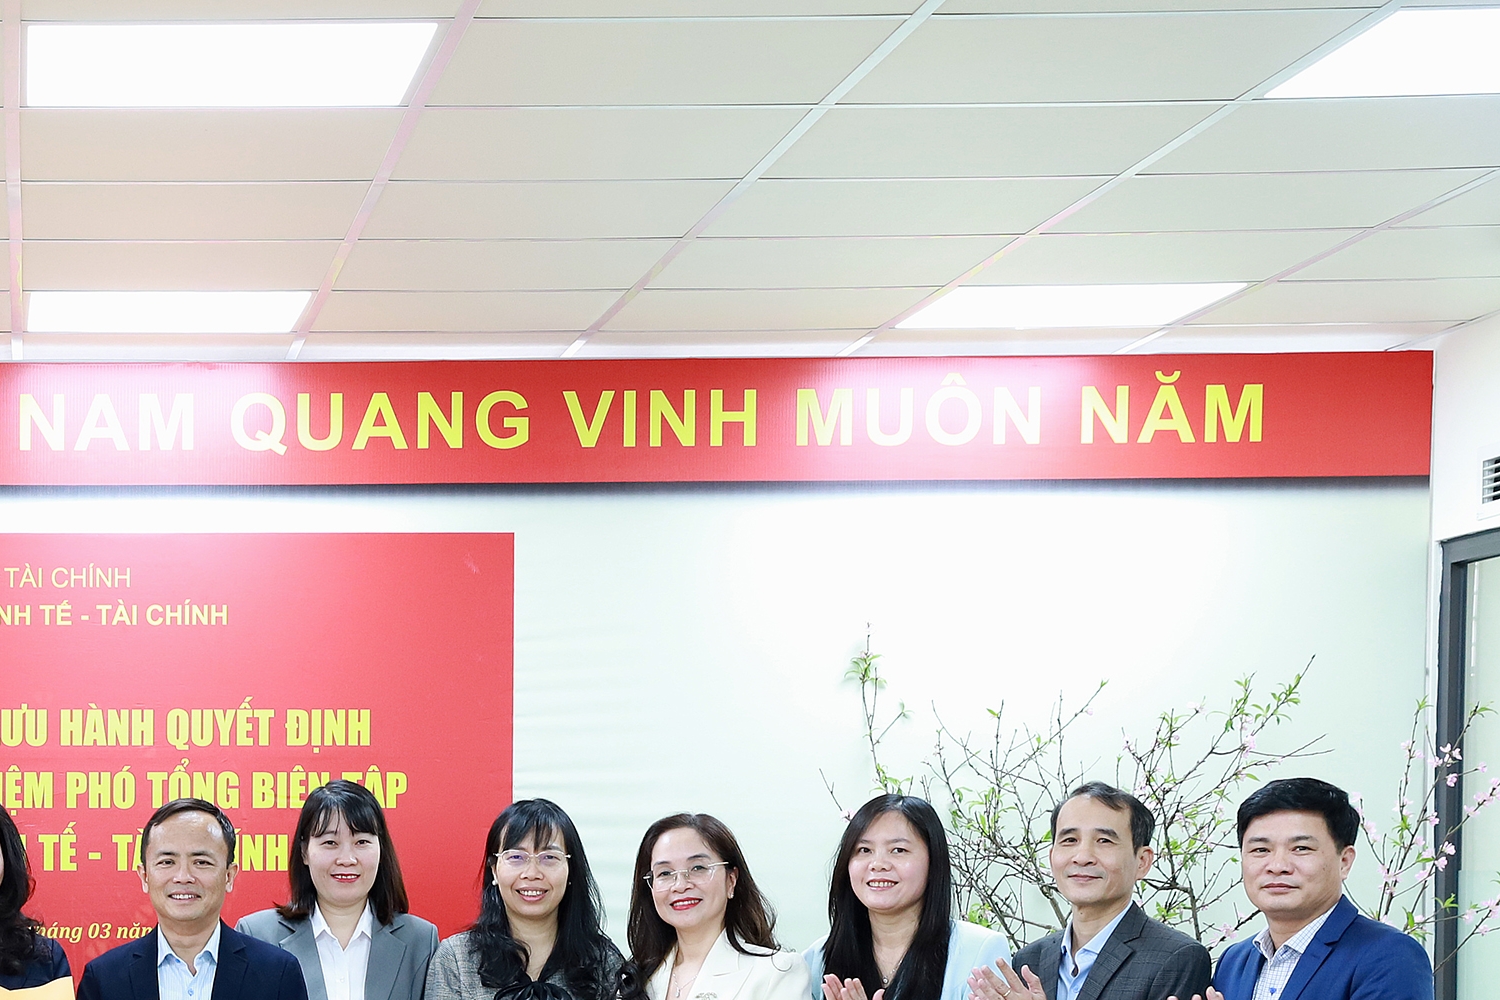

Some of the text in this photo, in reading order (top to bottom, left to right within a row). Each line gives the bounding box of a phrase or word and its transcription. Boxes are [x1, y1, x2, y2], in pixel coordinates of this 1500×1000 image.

[19, 393, 195, 451] NAM
[230, 390, 530, 456] QUANG
[563, 389, 757, 448] VINH
[796, 373, 1041, 446] MUÔN
[1080, 370, 1264, 444] NĂM
[4, 563, 42, 588] TÀI
[51, 563, 131, 588] CHÍNH
[40, 599, 72, 626] TẾ
[96, 599, 138, 626] TÀI
[146, 599, 228, 626] CHÍNH
[60, 702, 154, 746] HÀNH
[166, 696, 275, 750] QUYẾT
[285, 708, 371, 753] ĐỊNH
[66, 766, 135, 809] PHÓ
[147, 758, 240, 809] TỔNG
[38, 822, 77, 871] TẾ
[88, 922, 112, 939] 03
